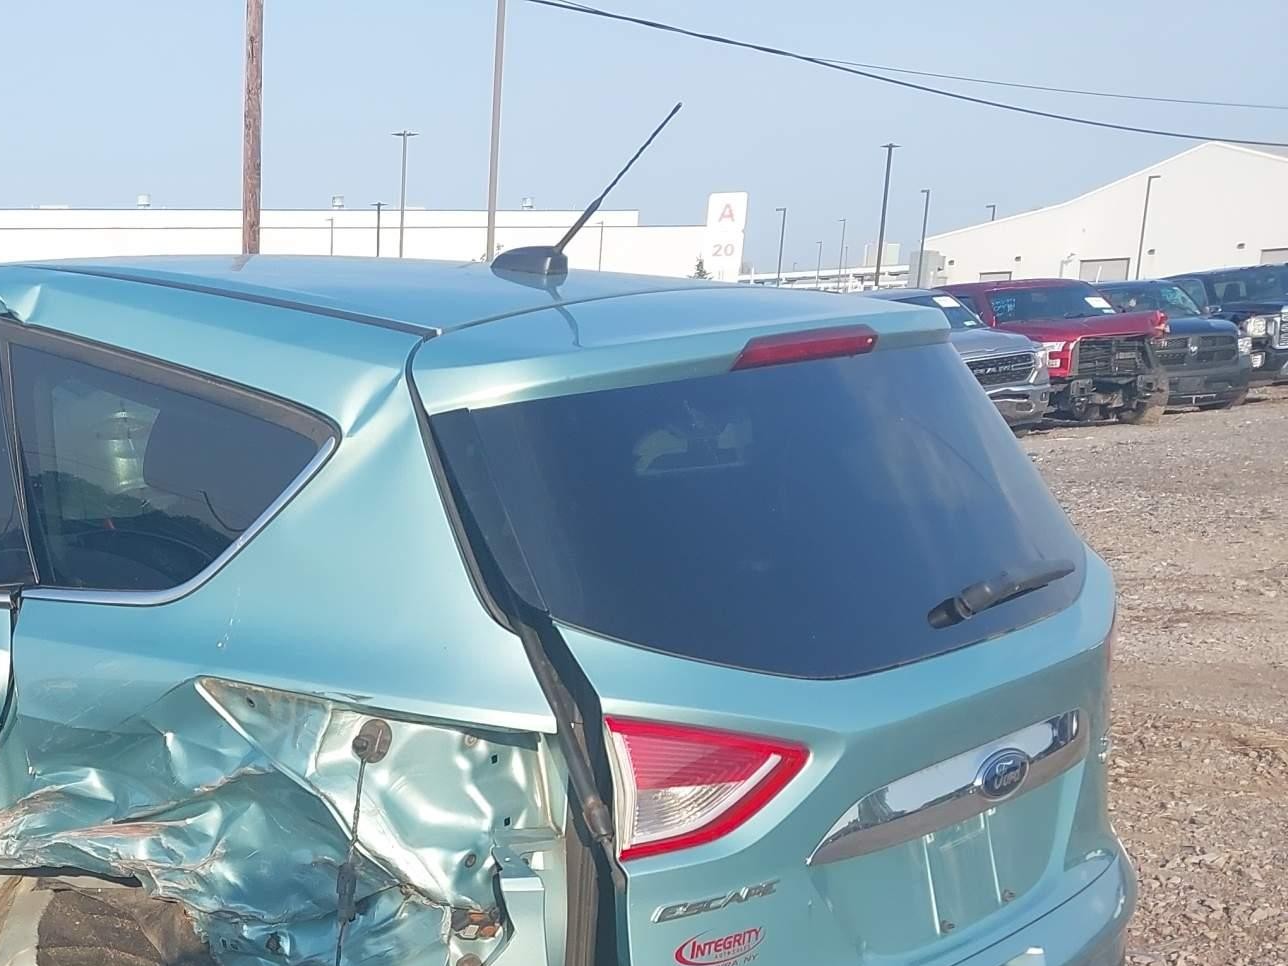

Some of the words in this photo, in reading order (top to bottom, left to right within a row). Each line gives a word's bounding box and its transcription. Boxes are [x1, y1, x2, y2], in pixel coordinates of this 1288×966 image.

[718, 203, 735, 222] A
[712, 243, 735, 256] 20
[993, 759, 1021, 789] Ford
[650, 879, 781, 923] ESCAPE
[690, 926, 762, 959] INTEGRITY
[743, 953, 759, 965] NY
